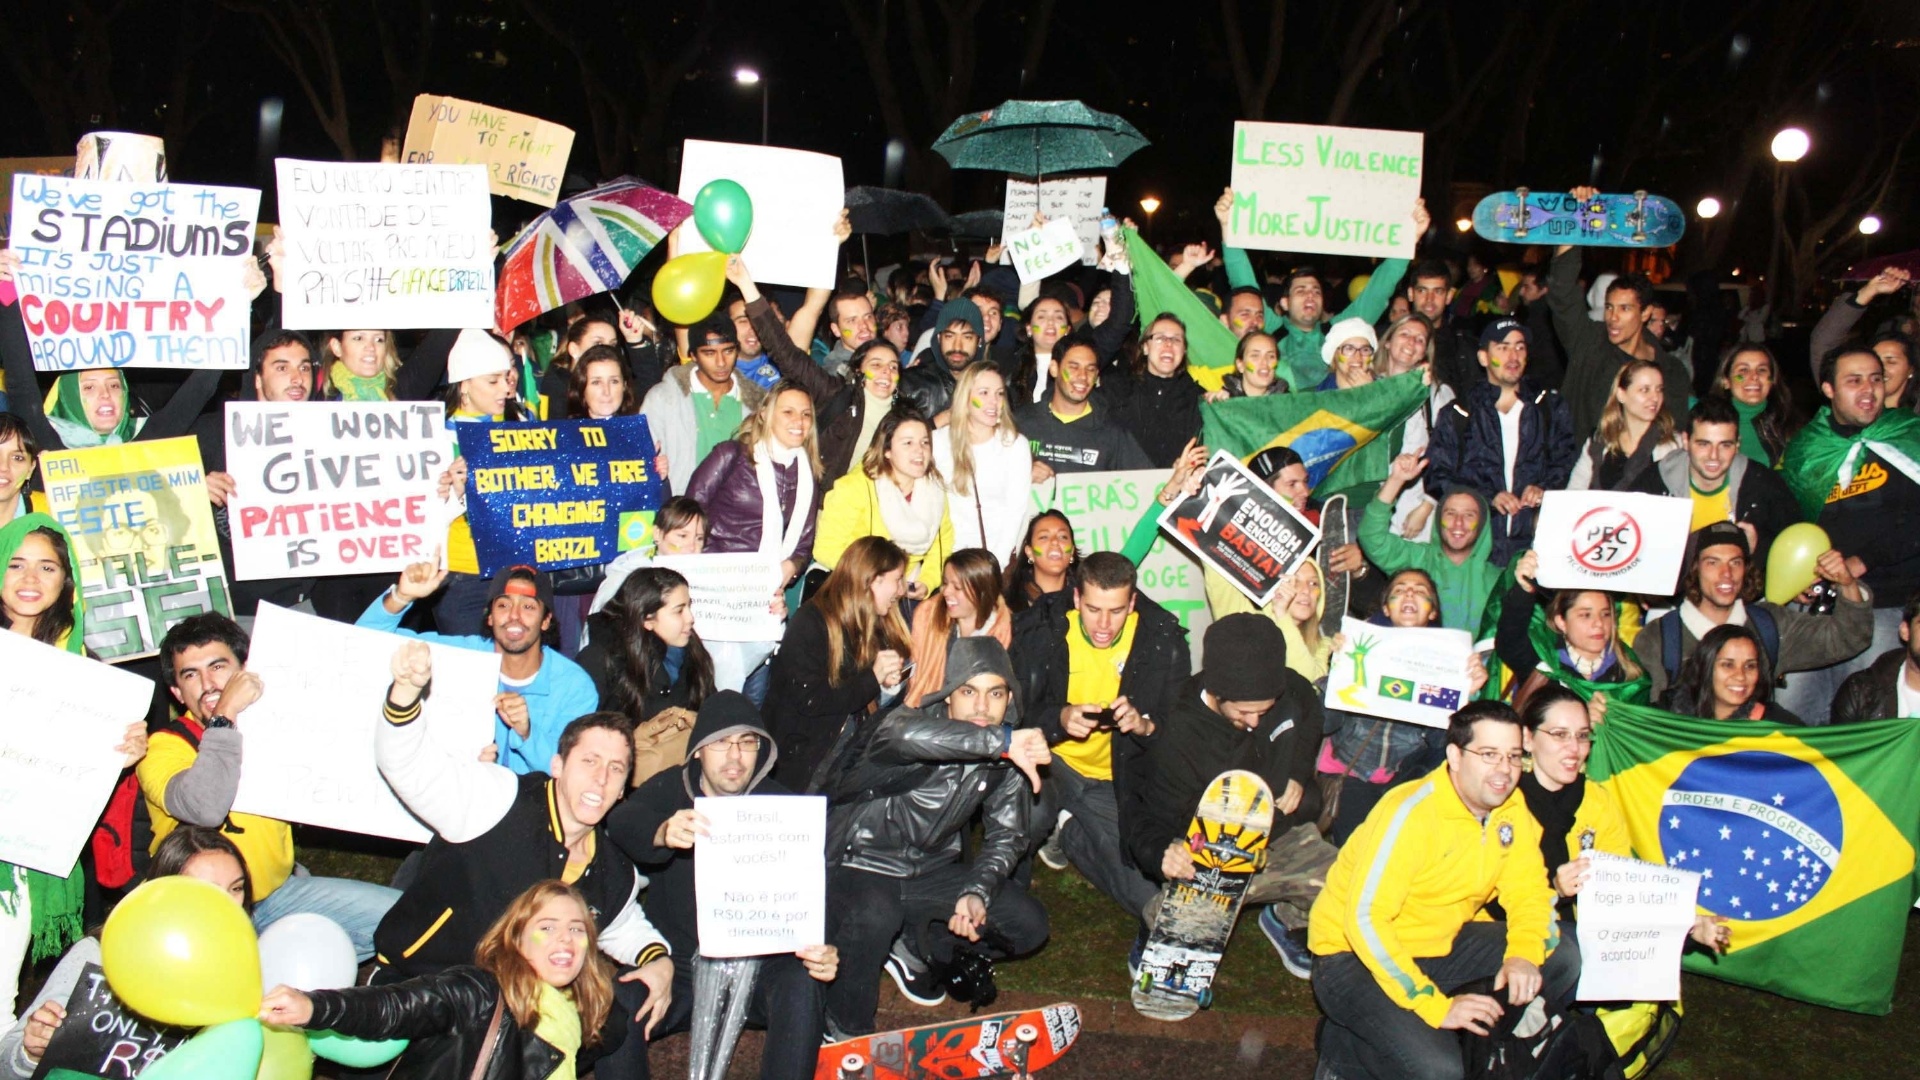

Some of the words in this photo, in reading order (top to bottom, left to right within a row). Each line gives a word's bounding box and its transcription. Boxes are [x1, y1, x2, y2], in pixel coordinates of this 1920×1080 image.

[428, 104, 460, 123] YOU
[468, 109, 508, 131] HAVE
[478, 131, 498, 147] TO
[407, 151, 434, 164] FOR
[294, 167, 327, 193] EU
[19, 176, 102, 211] We've
[124, 187, 175, 216] got
[193, 189, 240, 220] the
[295, 203, 399, 228] VONTADE
[407, 204, 448, 227] DE
[297, 237, 374, 264] VOLTAR
[425, 234, 476, 260] MEU
[1014, 232, 1041, 255] NO
[15, 246, 73, 270] IT'S
[89, 252, 164, 274] JUST
[1025, 252, 1052, 275] PEC
[174, 271, 194, 300] A
[21, 294, 225, 336] COUNTRY
[33, 331, 137, 371] AROUND
[232, 410, 293, 448] WE
[331, 404, 441, 440] WON'T
[489, 428, 557, 453] SORRY
[579, 427, 607, 447] TO
[397, 450, 441, 481] UP
[474, 464, 560, 494] BOTHER,
[570, 462, 599, 486] WE
[608, 459, 648, 483] ARE
[52, 478, 133, 502] AFASTA
[137, 472, 164, 491] DE
[168, 469, 201, 487] MIM
[1032, 478, 1140, 517] VERÁS
[57, 501, 148, 536] ESTE
[512, 499, 606, 528] CHANGING
[1239, 497, 1303, 553] ENOUGH
[1231, 509, 1247, 524] IS
[1245, 521, 1293, 562] ENOUGH!
[1587, 526, 1630, 544] PEC
[535, 536, 601, 563] BRAZIL
[1219, 522, 1283, 578] BASTA!
[1591, 546, 1619, 562] 37
[1577, 564, 1588, 574] DA
[1589, 557, 1642, 578] IMPUNIDADE
[726, 600, 771, 610] AUSTRALIA
[709, 832, 773, 845] estamos
[778, 832, 810, 843] com
[1671, 792, 1724, 807] ORDEM
[1732, 796, 1741, 810] E
[1747, 803, 1832, 858] PROGRESSO
[1595, 870, 1621, 883] filho
[1625, 870, 1647, 883] teu
[1652, 872, 1680, 885] não
[724, 890, 754, 903] Não
[759, 890, 768, 902] é
[773, 891, 799, 904] por
[1594, 891, 1622, 906] foge
[1627, 894, 1635, 904] a
[1639, 891, 1677, 904] luta!!!
[771, 909, 780, 921] é
[785, 910, 809, 923] por
[1597, 929, 1609, 940] O
[1612, 929, 1660, 943] gigante
[1600, 947, 1655, 962] acordou!!
[91, 1010, 168, 1046] ONLY
